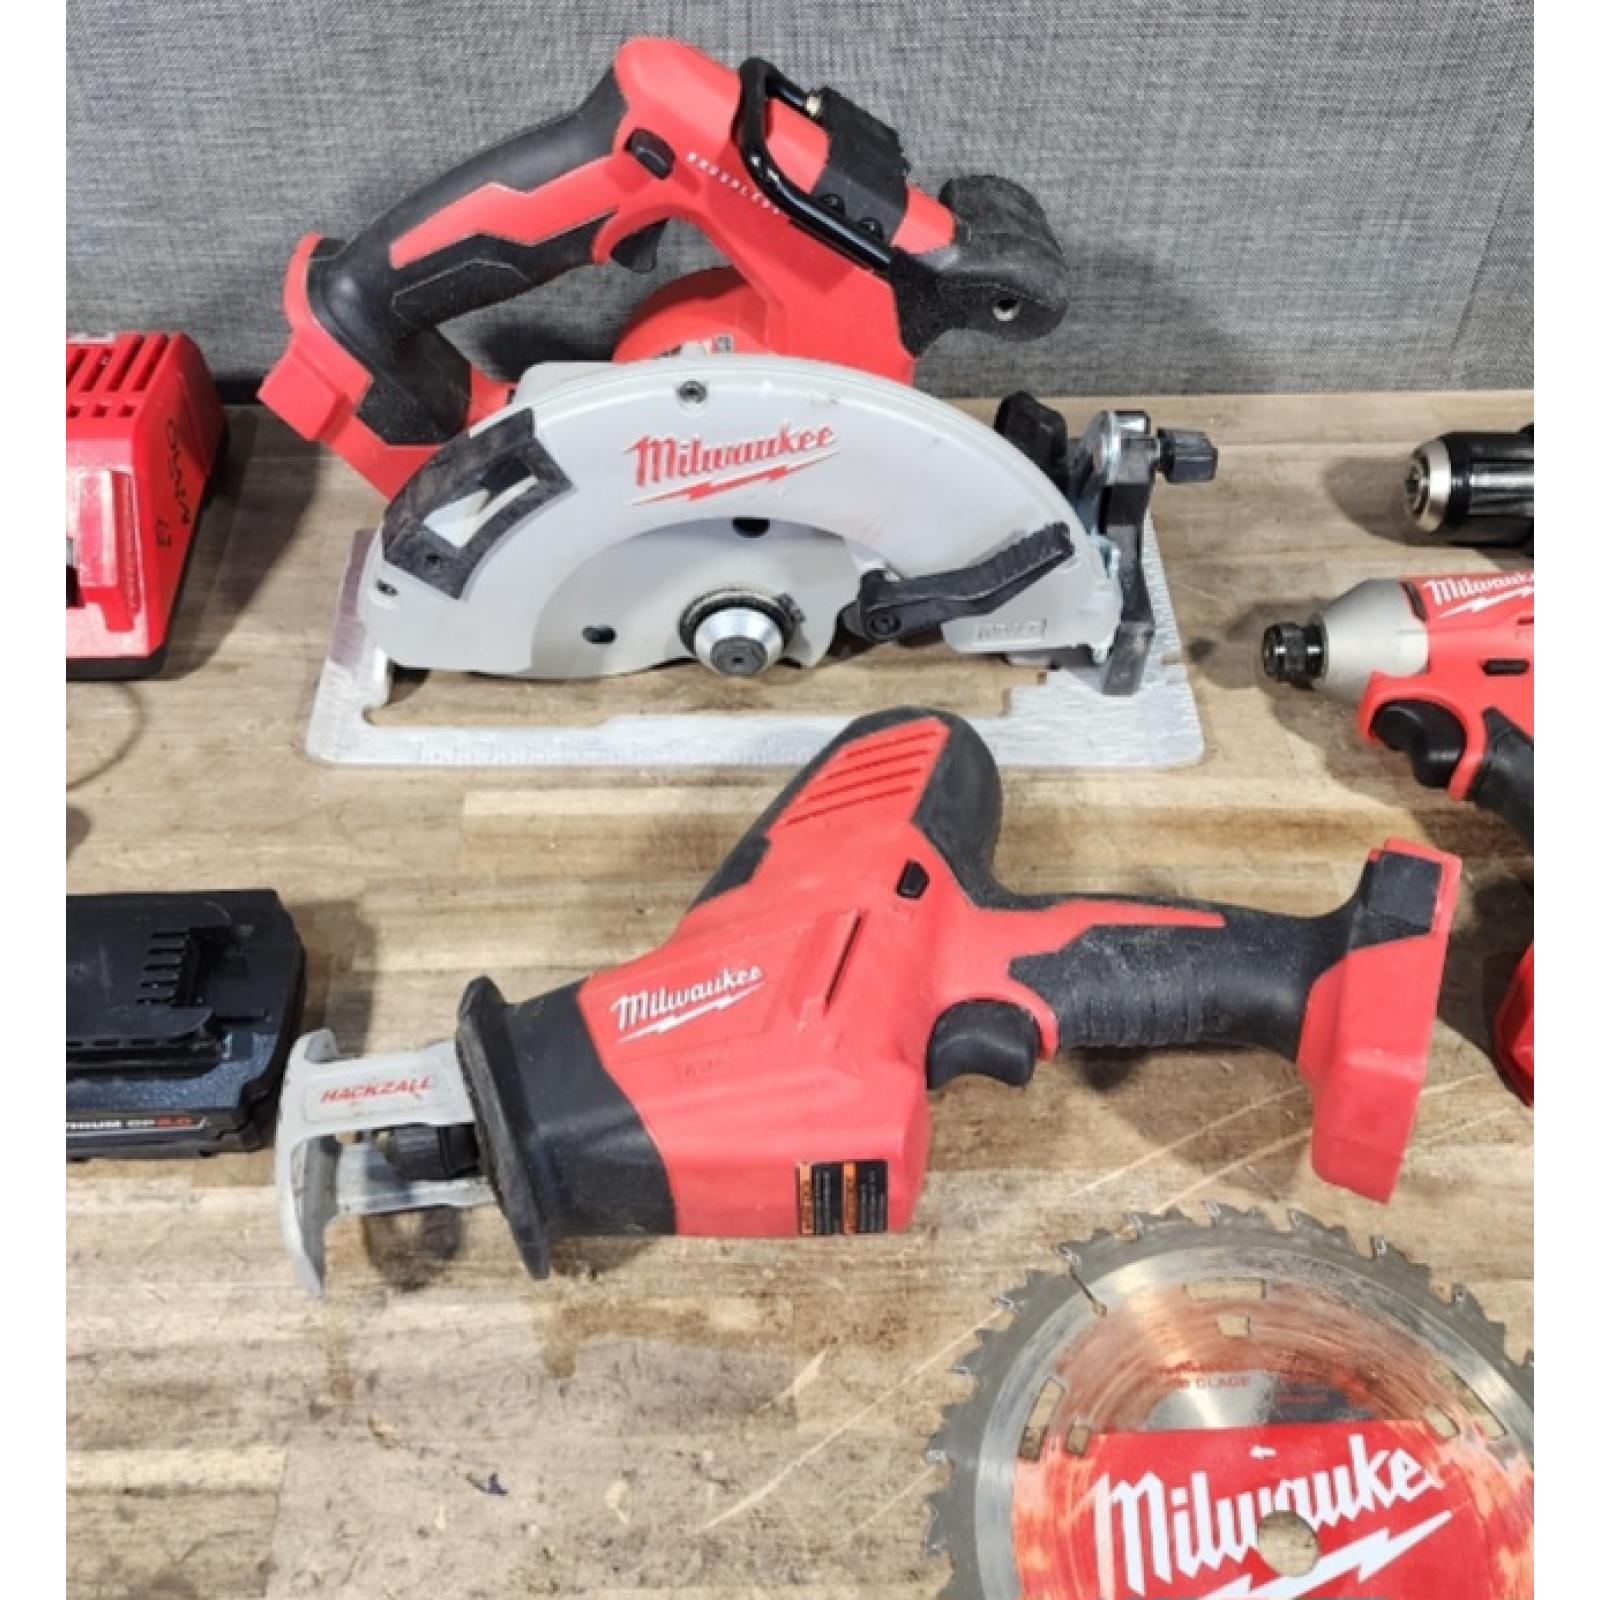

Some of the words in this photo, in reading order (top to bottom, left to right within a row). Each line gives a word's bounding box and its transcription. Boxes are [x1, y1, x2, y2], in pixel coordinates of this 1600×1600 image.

[623, 419, 837, 488] Milwaukee
[609, 965, 763, 1031] Milwaukee
[320, 1073, 433, 1105] HACKZALL
